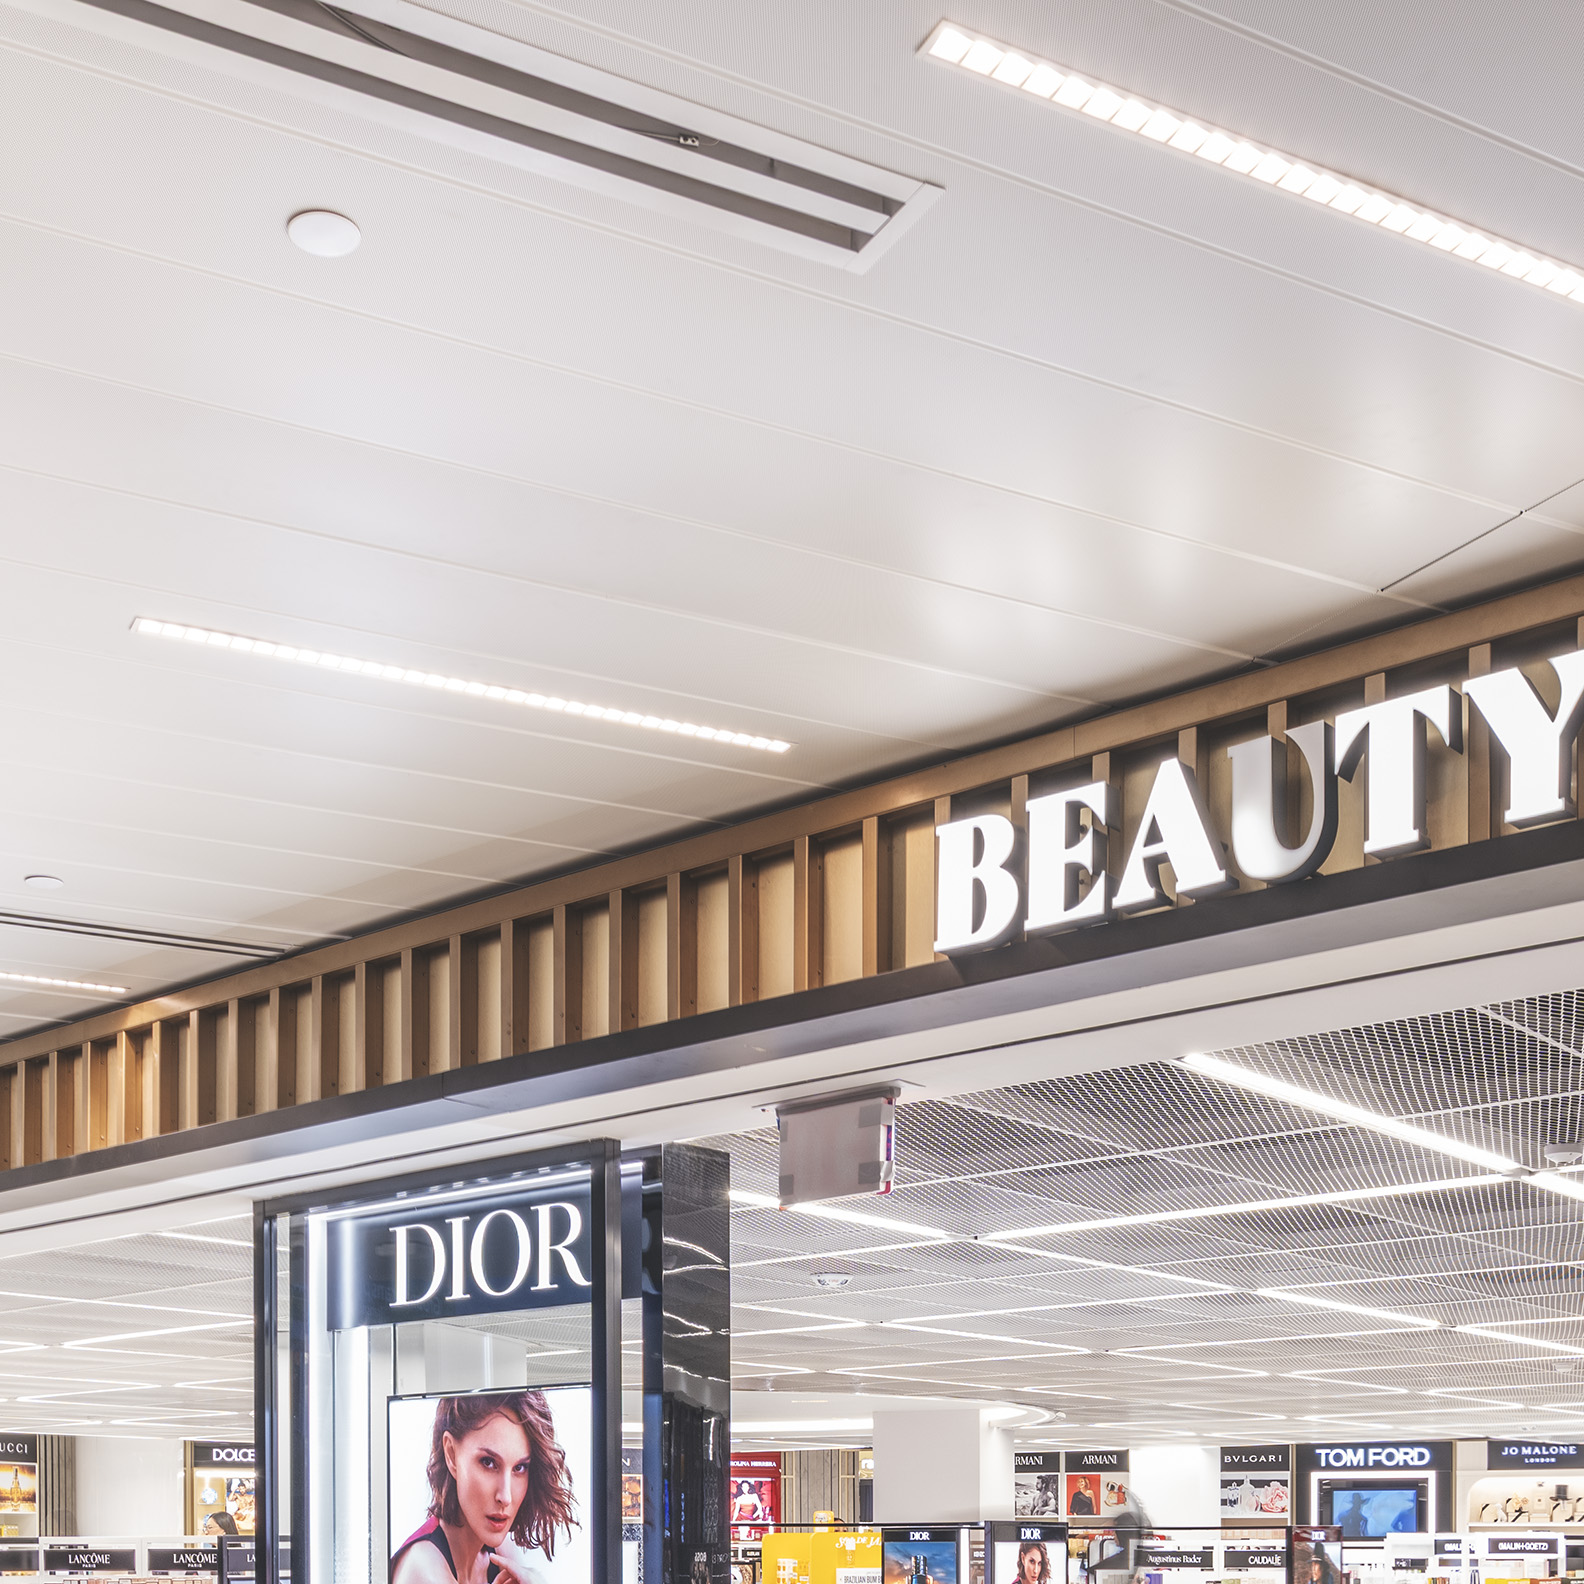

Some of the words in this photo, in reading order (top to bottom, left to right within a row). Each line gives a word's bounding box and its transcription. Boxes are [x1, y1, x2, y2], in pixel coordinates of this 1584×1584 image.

[389, 1202, 592, 1307] DIOR
[213, 1448, 255, 1461] DOLCE
[1502, 1446, 1518, 1455] JO
[1521, 1446, 1577, 1455] MALONE
[1082, 1455, 1117, 1465] ARMANI
[1224, 1455, 1282, 1463] BVLGARI
[1316, 1448, 1364, 1467] TOM
[1368, 1448, 1430, 1466] FORD
[910, 1532, 930, 1541] DIOR
[1021, 1528, 1041, 1540] DIOR
[68, 1552, 110, 1564] LANCÔME
[173, 1552, 217, 1564] LANCÔME
[1147, 1555, 1182, 1565] Augustinus
[1183, 1555, 1202, 1563] Bader
[844, 1575, 865, 1584] BRAZILIAN
[866, 1576, 878, 1584] BUM
